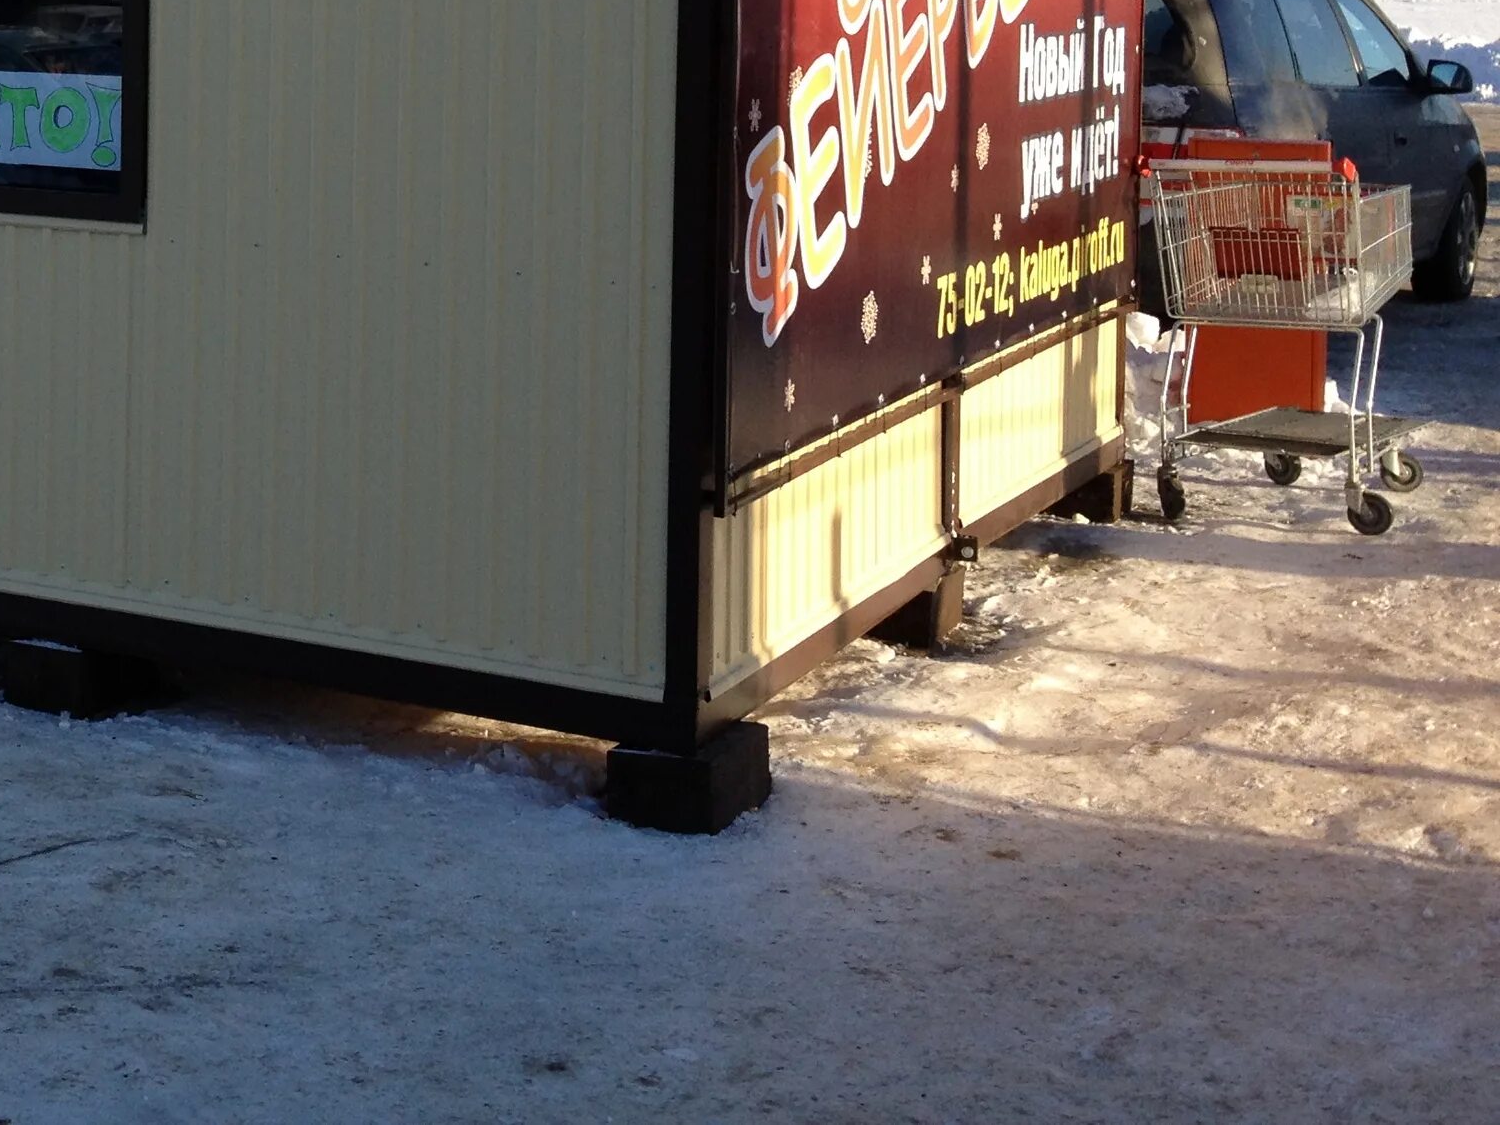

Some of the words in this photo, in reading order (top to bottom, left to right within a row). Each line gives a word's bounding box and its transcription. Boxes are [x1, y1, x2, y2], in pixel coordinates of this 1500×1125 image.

[1019, 18, 1085, 103] Новый
[1093, 15, 1125, 95] Год
[1020, 132, 1064, 219] уже
[1070, 104, 1119, 195] идёт!
[937, 252, 1014, 339] 75-02-12;
[1019, 216, 1125, 303] kaluga.piroff.ru
